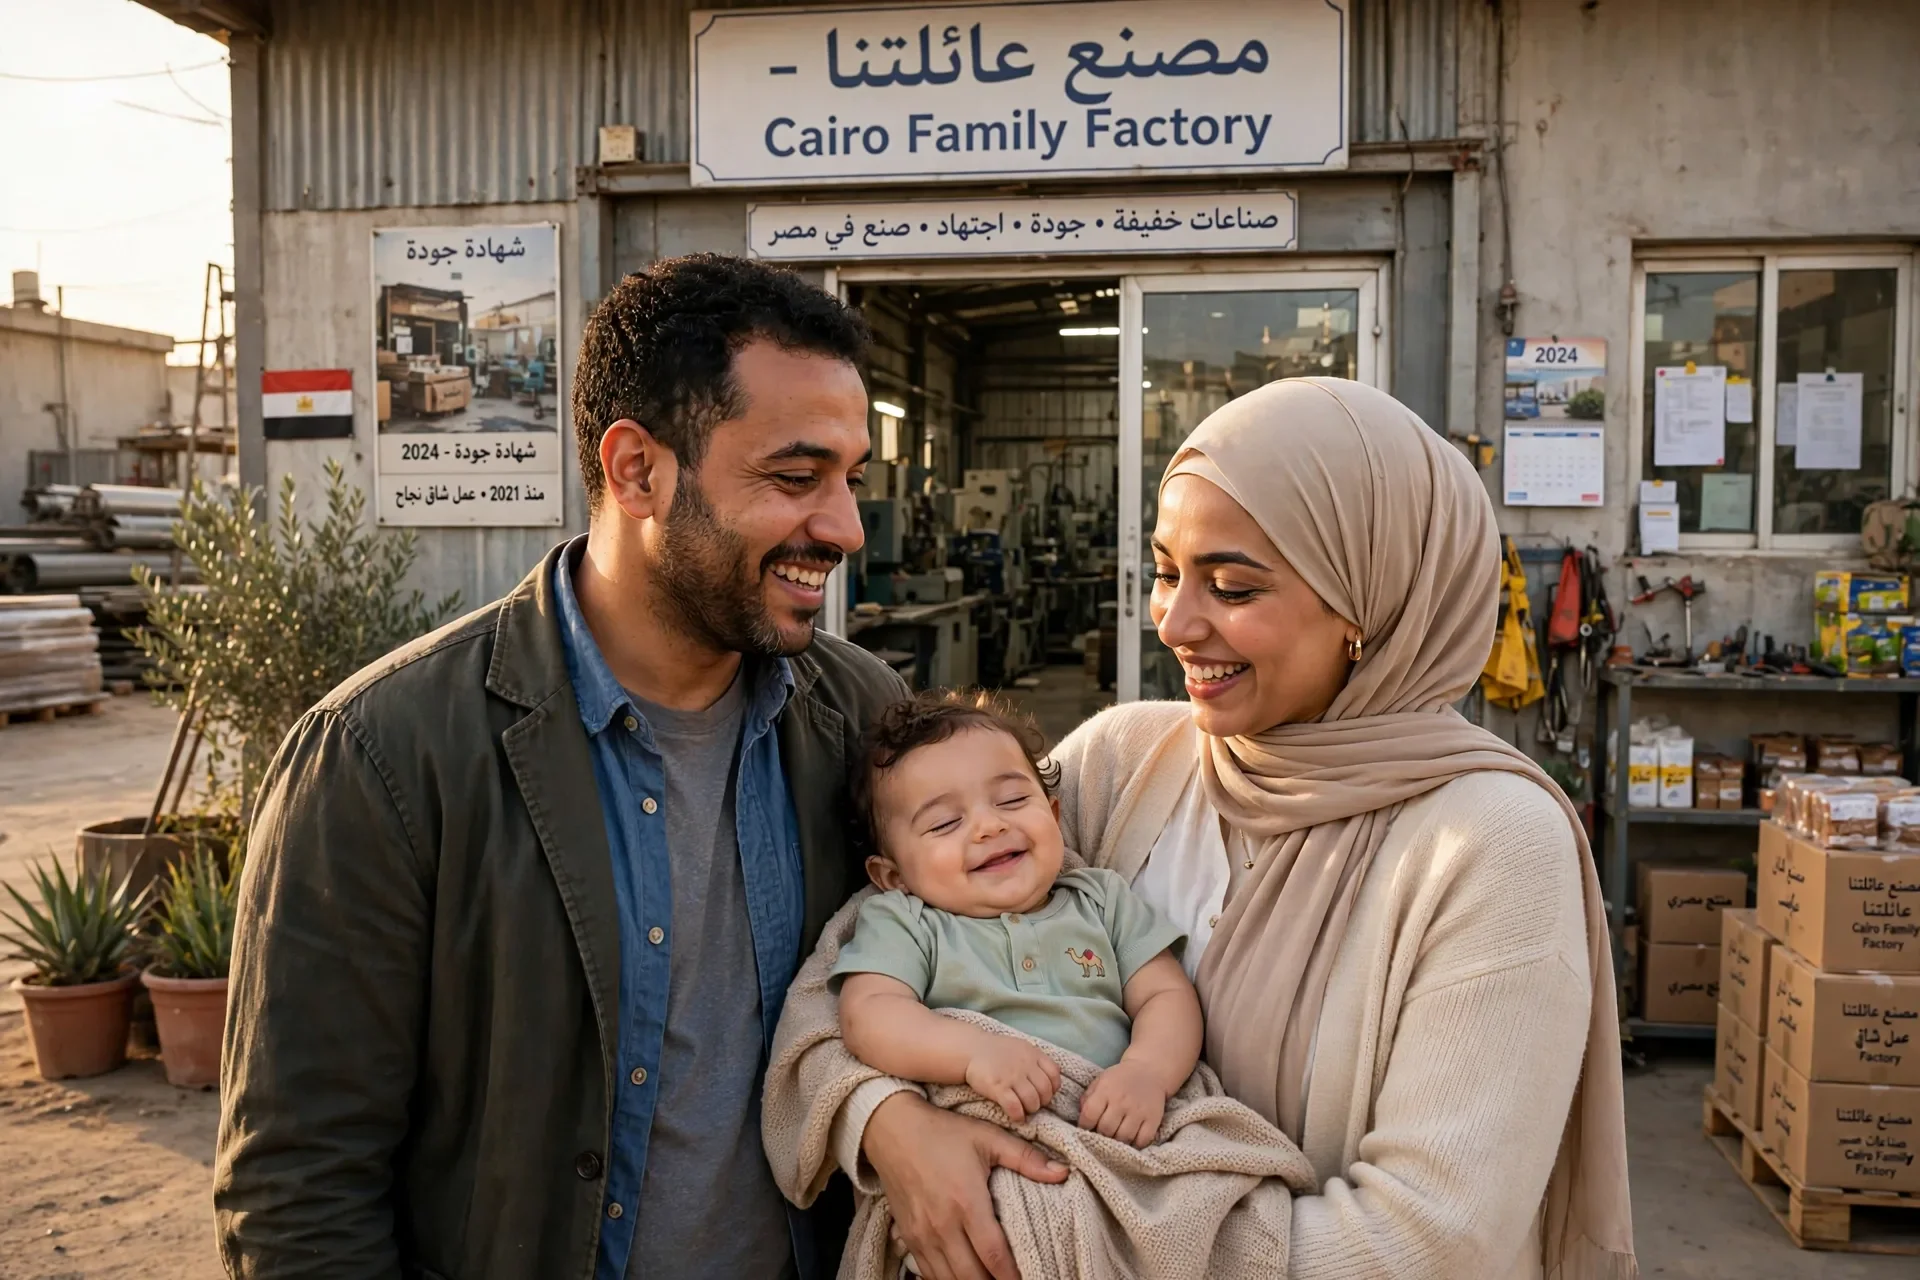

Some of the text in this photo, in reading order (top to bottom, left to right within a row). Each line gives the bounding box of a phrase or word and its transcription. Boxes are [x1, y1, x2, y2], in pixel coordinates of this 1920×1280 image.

[826, 22, 1035, 89] عائلتنا
[1064, 26, 1269, 104] مصنع
[764, 107, 1273, 160] Cairo Family Factory
[767, 206, 1279, 251] صناعات خفيفة جودة اجتهاد صنع في مصر
[406, 236, 526, 266] شهادة جودة
[1535, 346, 1579, 364] 2024
[402, 443, 440, 461] 2024
[455, 443, 491, 464] جودة
[495, 441, 537, 463] شهادة
[395, 485, 545, 508] منذ 2021 عمل شاق نجاح
[1887, 880, 1920, 899] صنع
[1852, 922, 1880, 934] Cairo
[1862, 937, 1904, 952] Factory
